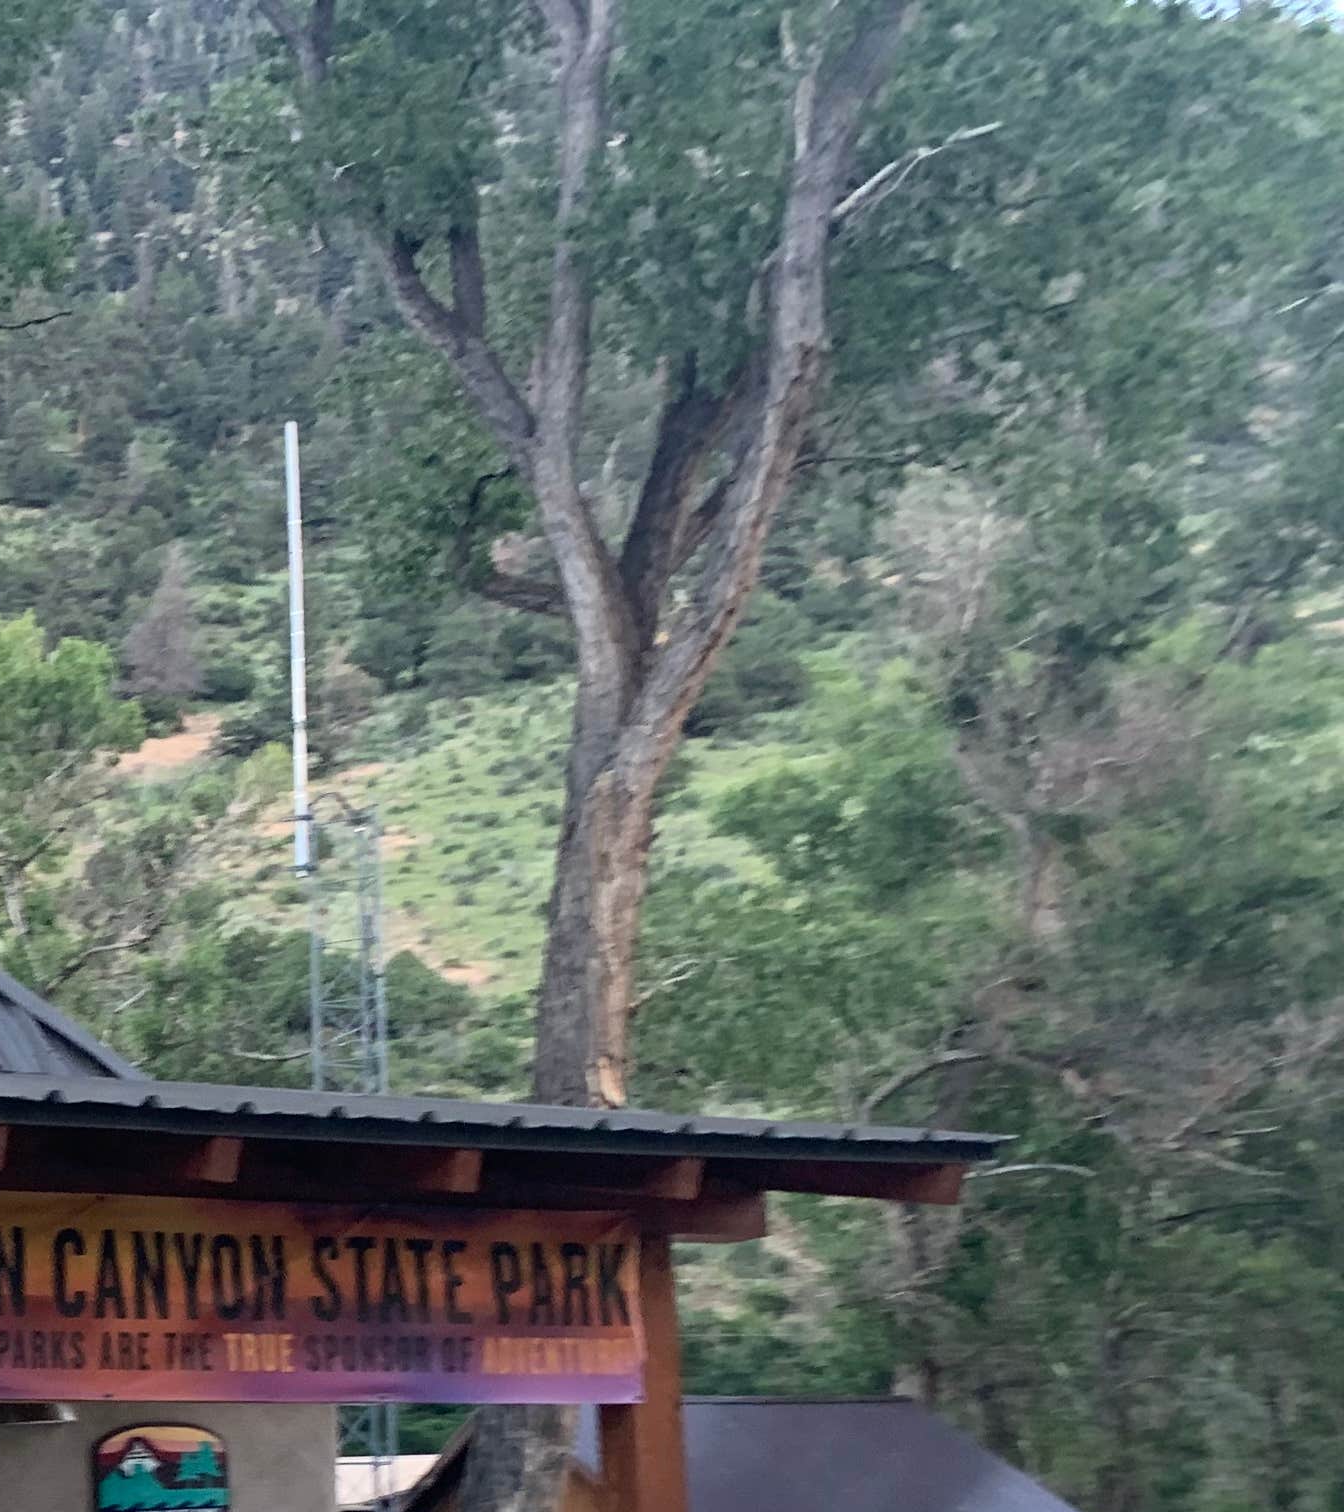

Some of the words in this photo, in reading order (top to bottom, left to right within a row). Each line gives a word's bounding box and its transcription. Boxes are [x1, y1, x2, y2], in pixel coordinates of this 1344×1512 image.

[52, 1227, 288, 1320] CANYON
[310, 1236, 473, 1324] STATE
[490, 1241, 632, 1327] PARK
[98, 1331, 150, 1371] ARE
[165, 1332, 213, 1371] THE
[223, 1333, 296, 1373] TRUE
[304, 1334, 431, 1374] SPONSOR
[442, 1336, 474, 1374] OF
